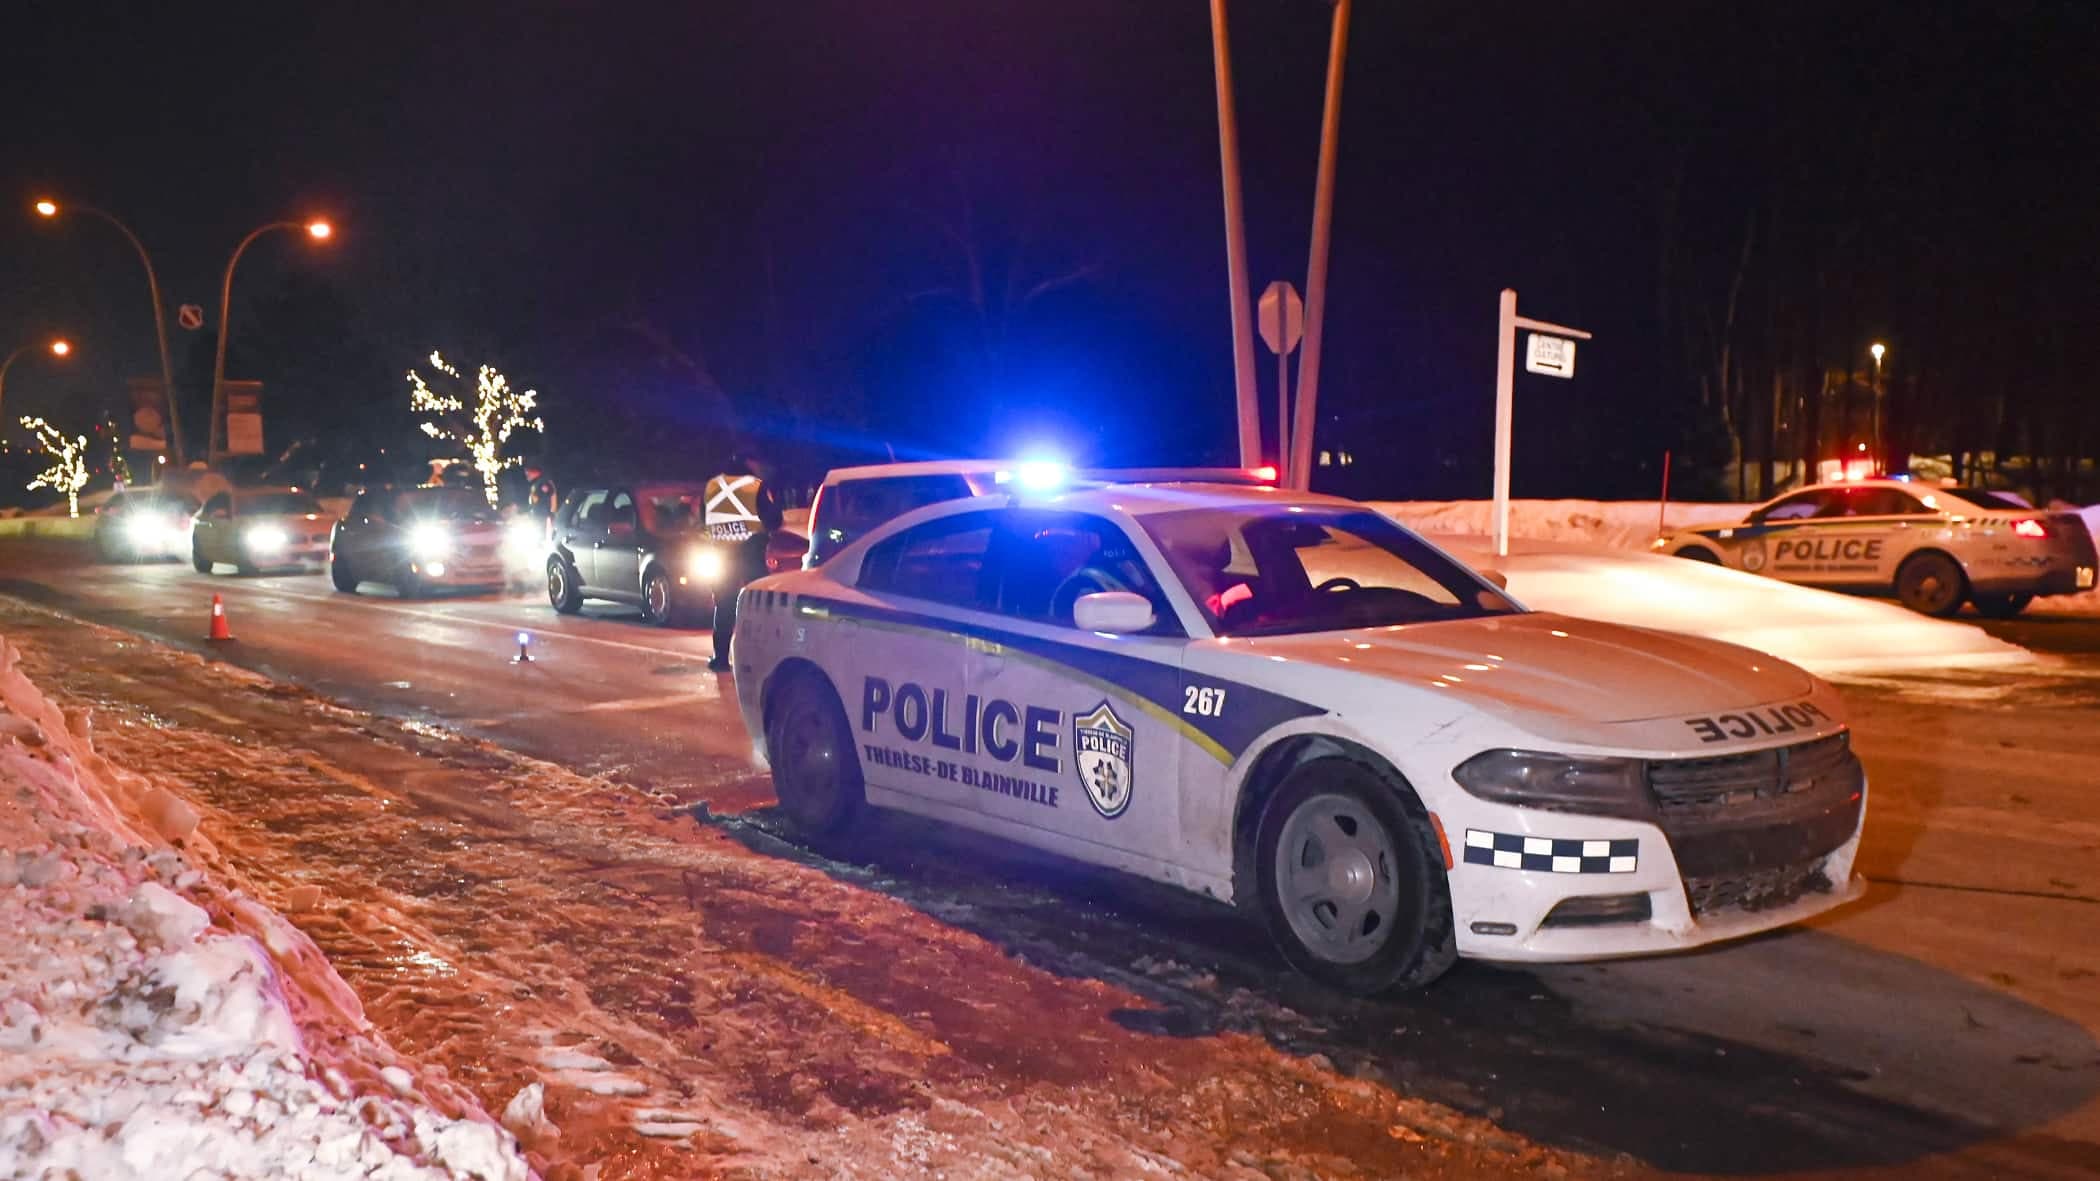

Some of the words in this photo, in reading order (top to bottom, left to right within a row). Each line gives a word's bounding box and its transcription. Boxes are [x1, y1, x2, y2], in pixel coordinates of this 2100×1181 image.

[711, 521, 747, 536] POLICE
[1775, 539, 1883, 560] POLICE
[1183, 685, 1226, 717] 267
[861, 675, 1066, 776] POLICE
[1081, 735, 1127, 760] POLICE
[961, 765, 1060, 808] BLAINVILLE
